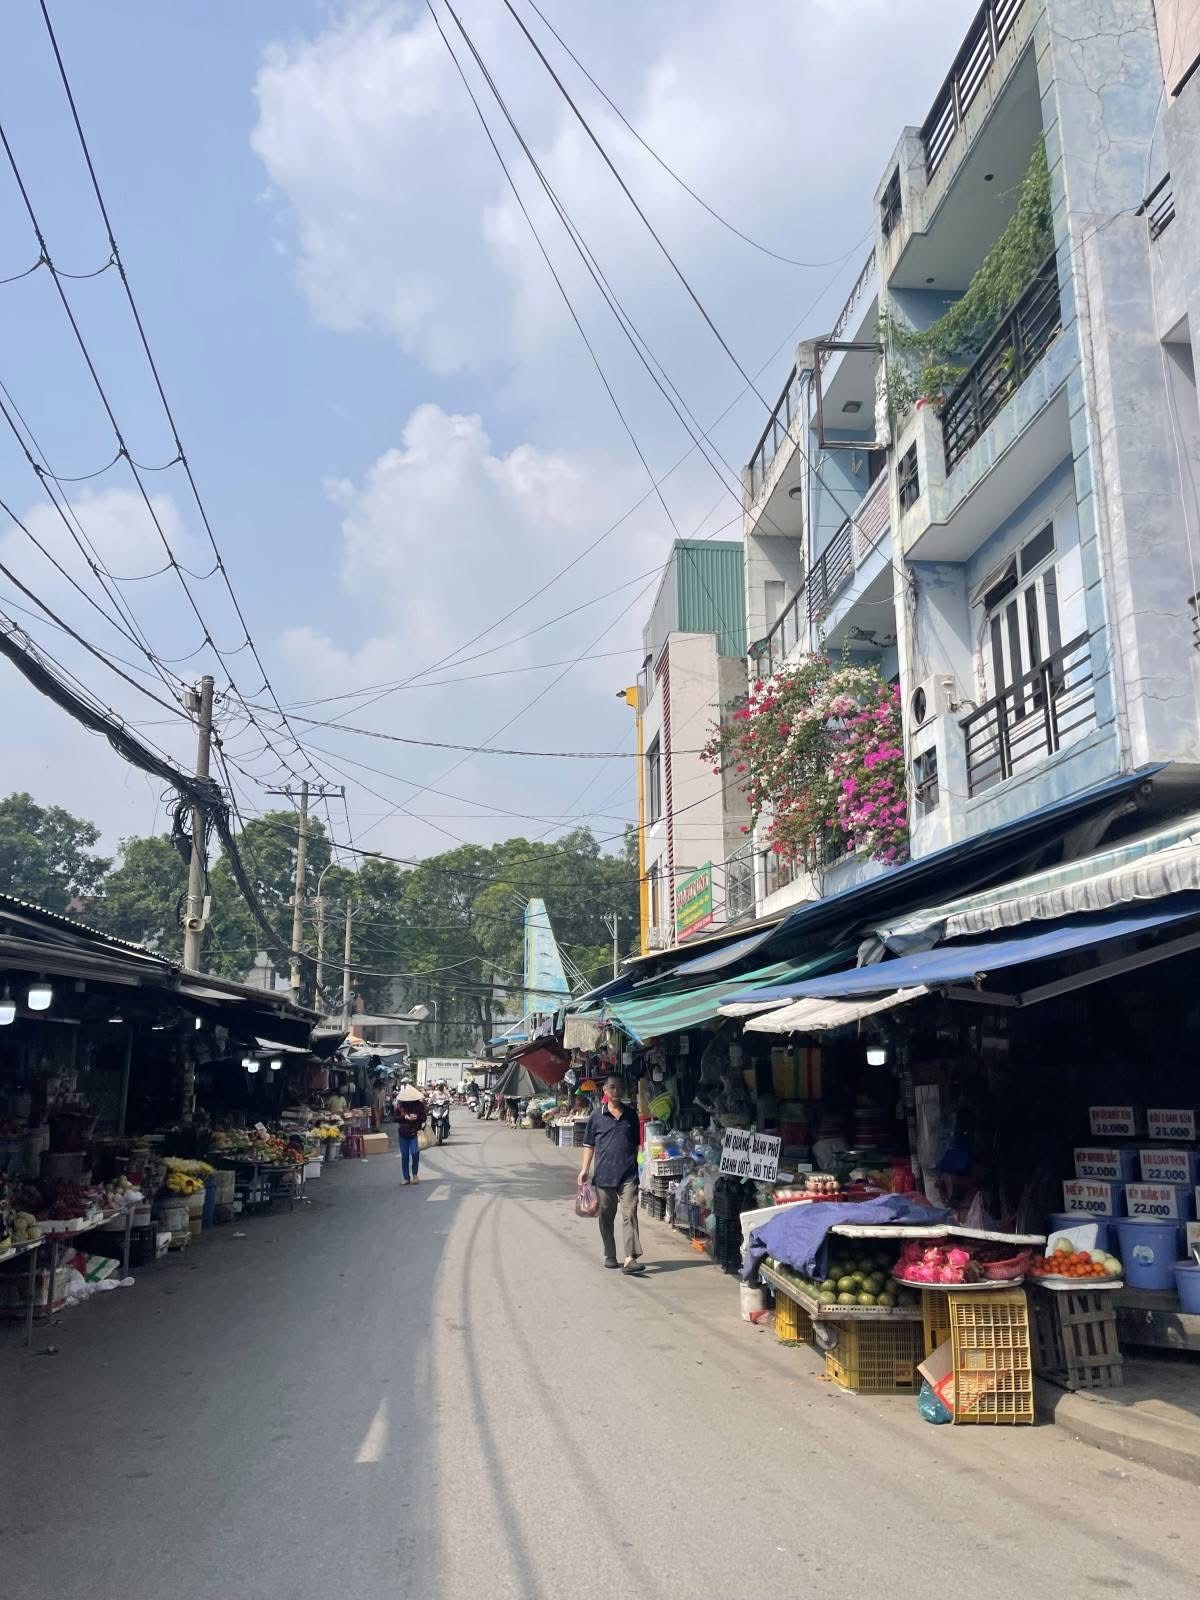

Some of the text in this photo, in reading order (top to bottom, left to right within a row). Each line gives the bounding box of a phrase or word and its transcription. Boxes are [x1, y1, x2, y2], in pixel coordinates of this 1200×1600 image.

[1148, 1169, 1186, 1180] 22.000
[1065, 1182, 1084, 1197] NẾP
[1070, 1199, 1106, 1212] 25.000
[1133, 1203, 1170, 1215] 22.000
